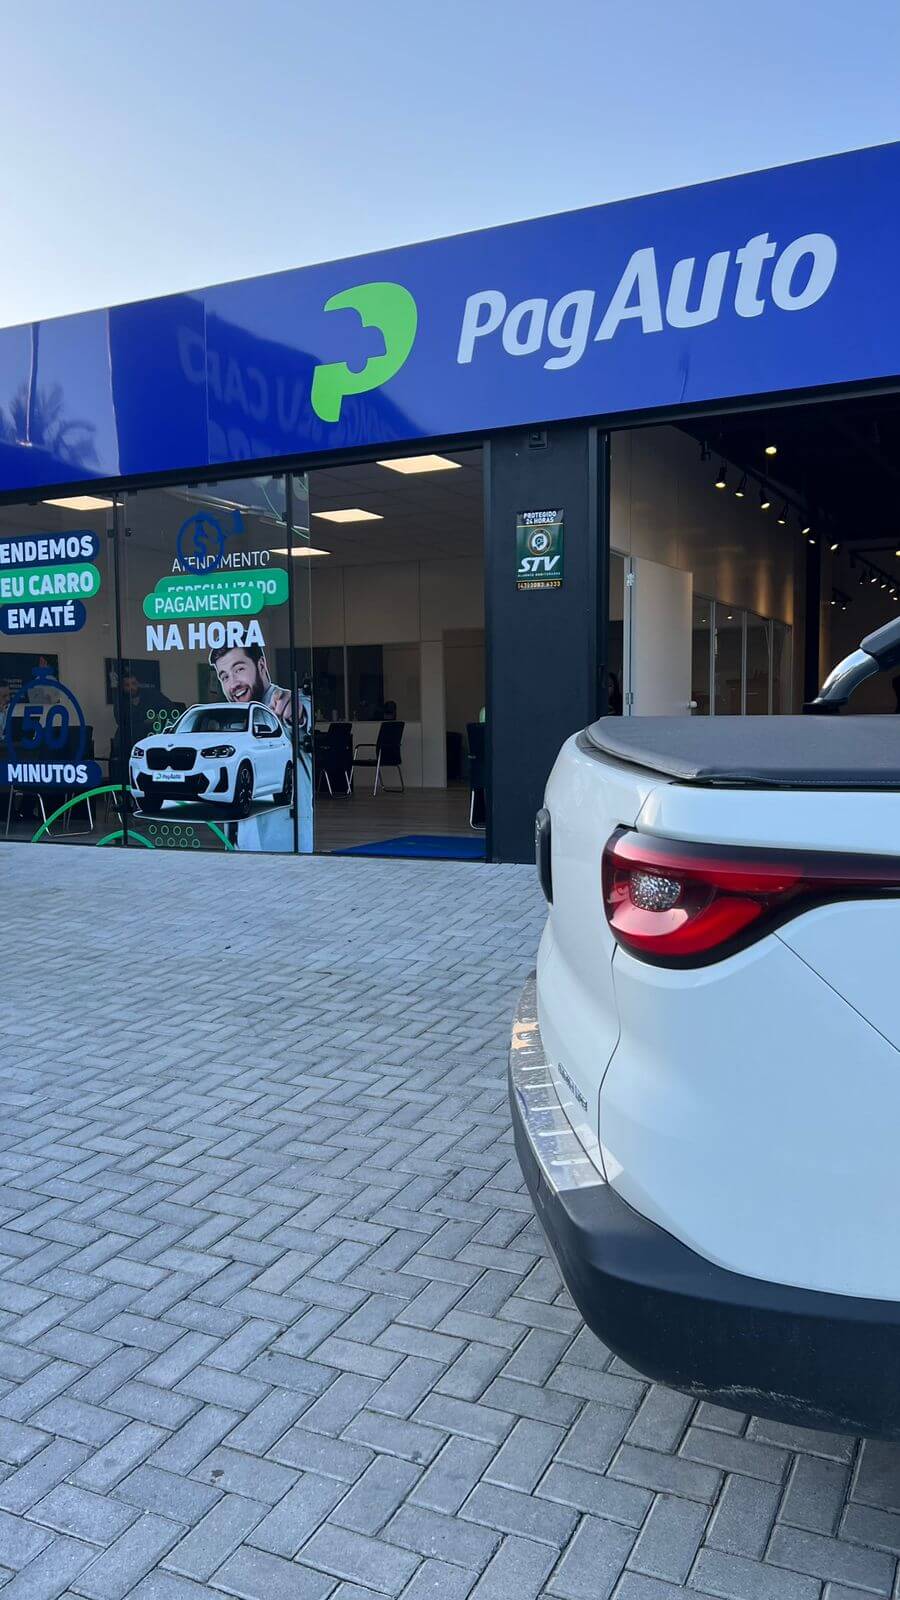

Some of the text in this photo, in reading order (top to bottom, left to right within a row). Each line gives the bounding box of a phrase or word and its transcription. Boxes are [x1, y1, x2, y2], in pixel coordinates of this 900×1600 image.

[457, 232, 837, 370] PagAuto
[523, 511, 556, 519] PROTEGIDO
[534, 517, 554, 525] HORAS
[0, 535, 93, 564] ENDEMOS
[518, 555, 560, 573] STV
[1, 571, 93, 598] EU CARRO
[8, 600, 75, 629] EM ATÉ
[154, 593, 252, 614] PAGAMENTO
[146, 620, 265, 651] NA HORA
[22, 705, 69, 748] 50
[8, 764, 88, 783] MINUTOS
